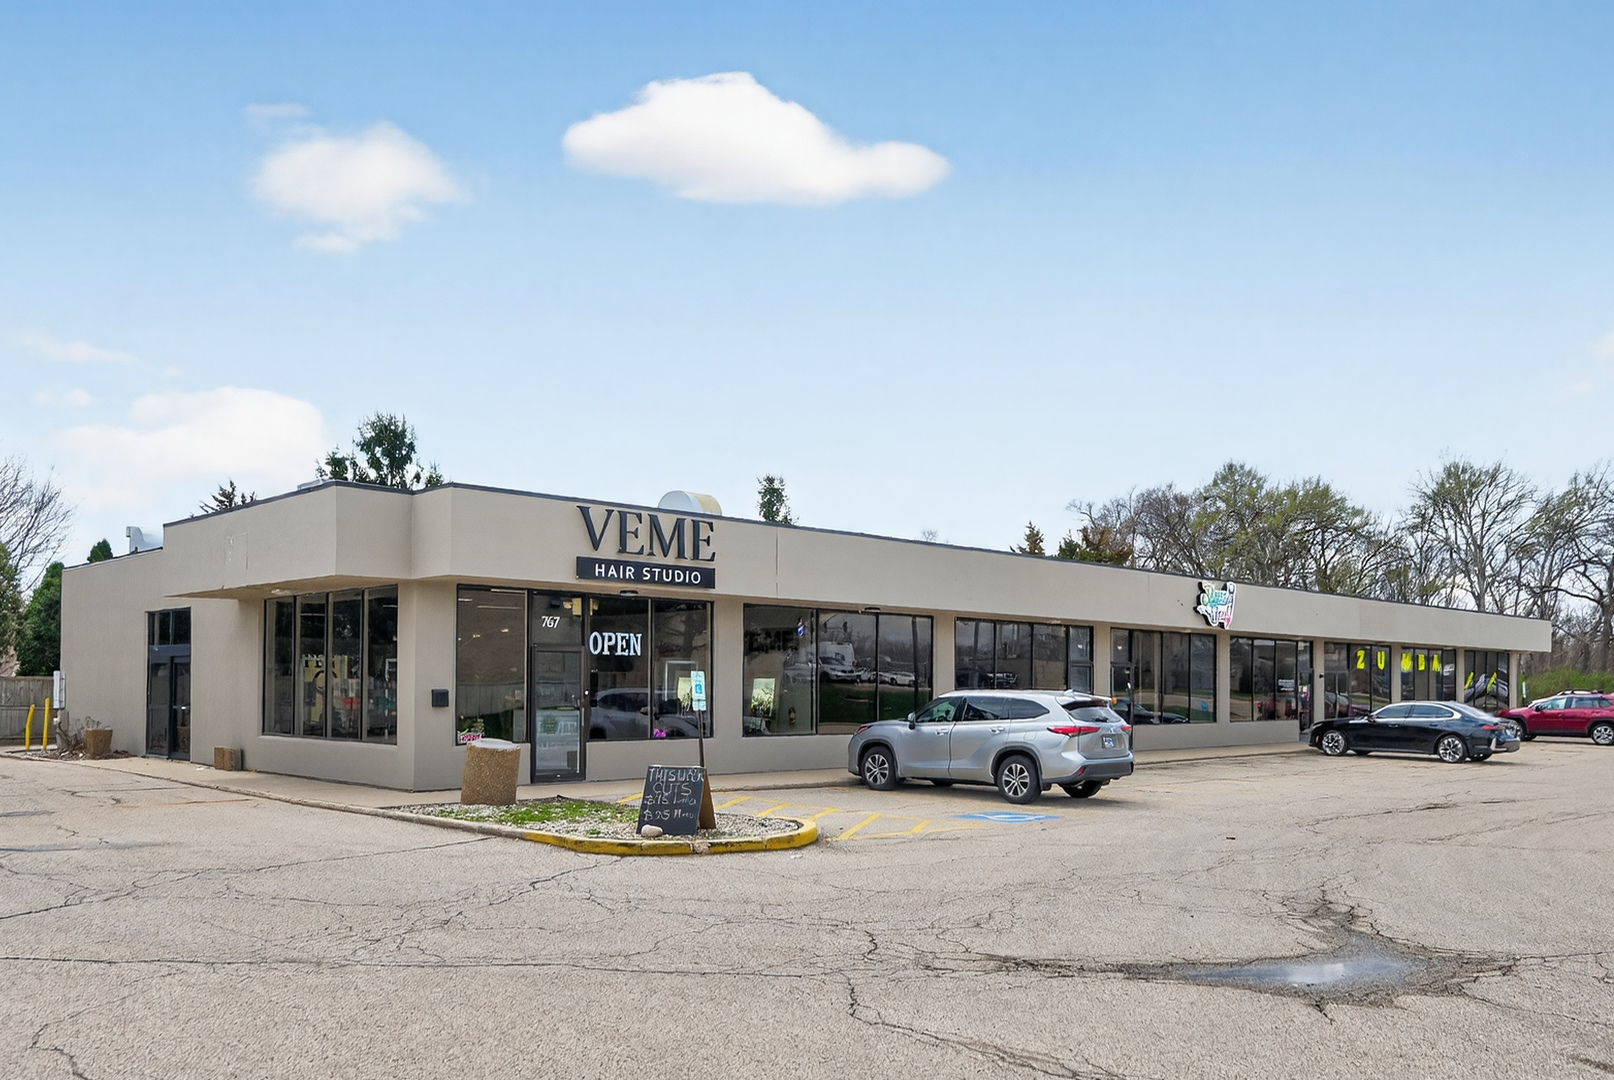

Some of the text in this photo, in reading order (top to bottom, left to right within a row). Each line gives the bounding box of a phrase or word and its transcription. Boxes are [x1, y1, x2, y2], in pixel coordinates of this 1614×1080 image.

[576, 505, 716, 562] VEME
[595, 563, 701, 584] HAIR STUDIO
[541, 615, 560, 628] 767
[589, 631, 642, 656] OPEN
